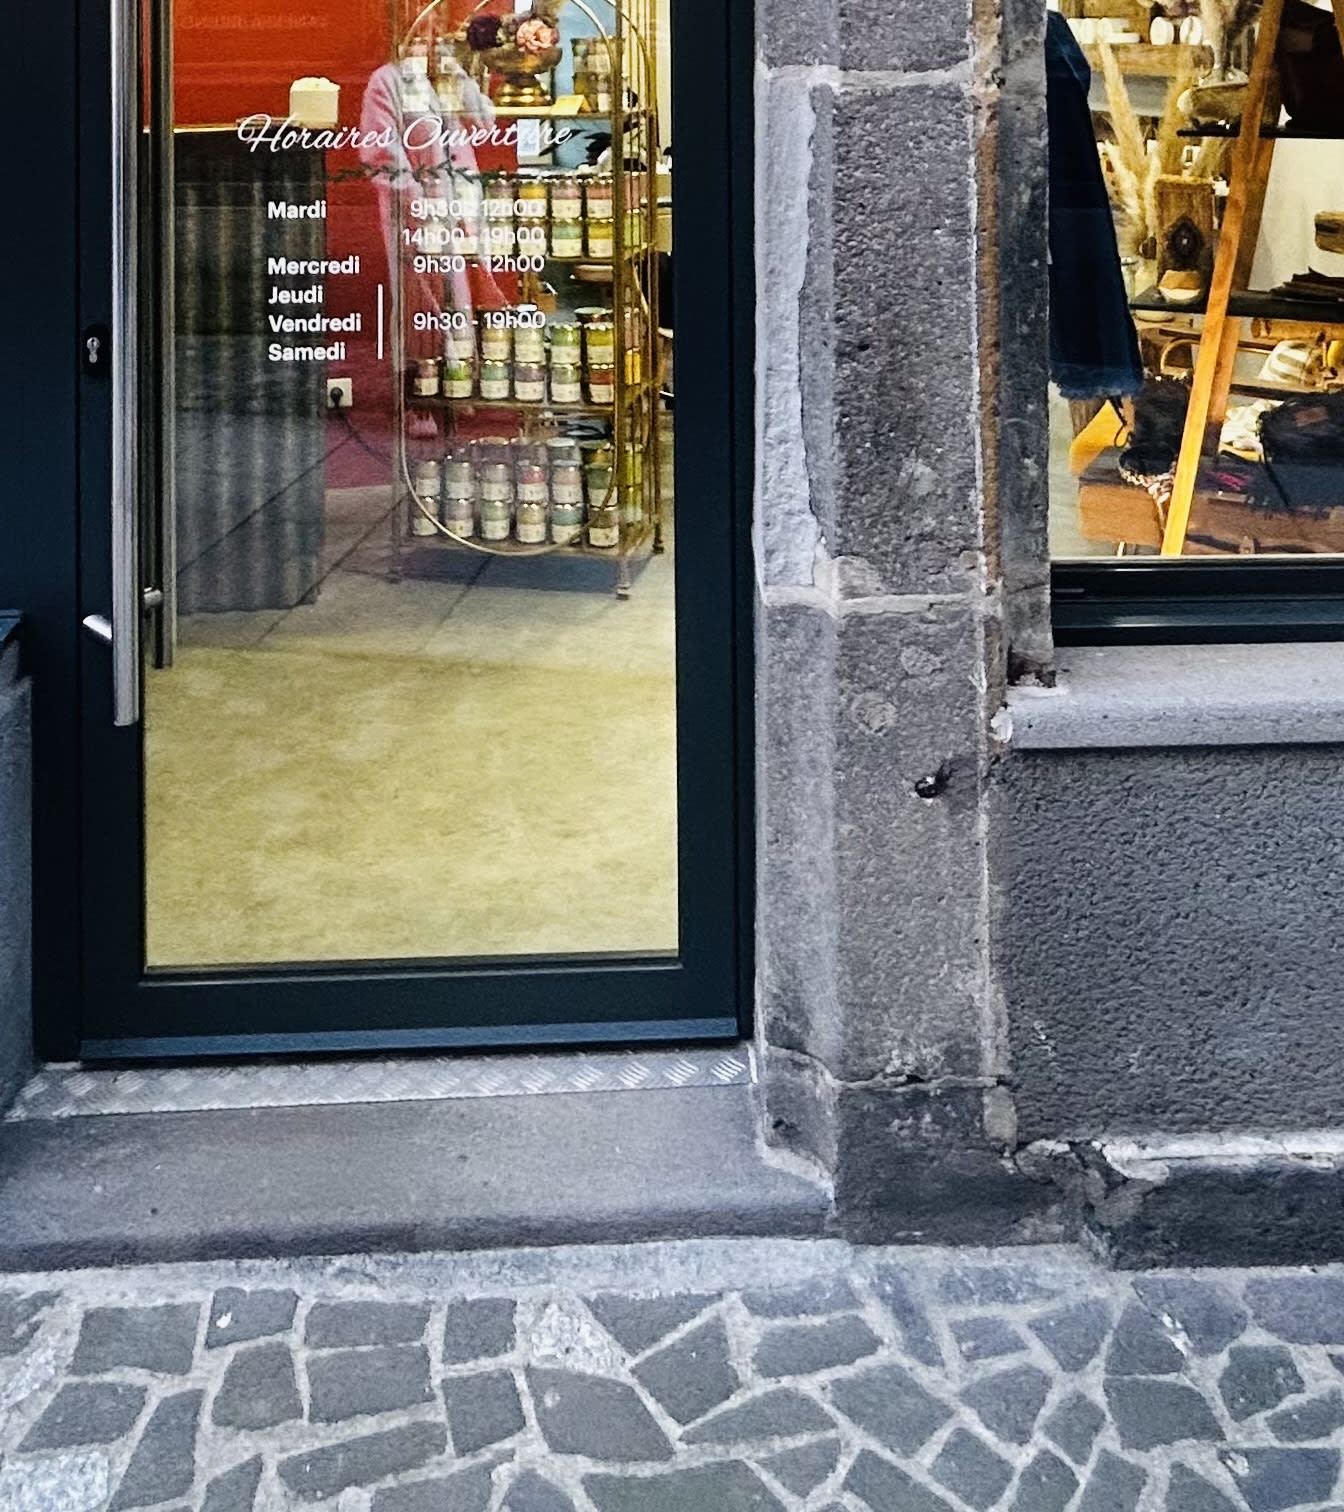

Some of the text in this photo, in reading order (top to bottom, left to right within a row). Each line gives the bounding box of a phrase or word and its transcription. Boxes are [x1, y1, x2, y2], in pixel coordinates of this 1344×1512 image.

[237, 114, 394, 153] Horaires
[267, 199, 542, 220] Mardi 9h30 12h00
[402, 227, 465, 246] 14h00
[482, 227, 545, 246] 19h00
[267, 255, 360, 276] Mercredi
[413, 255, 465, 273] 9h30
[485, 255, 545, 273] 12h00
[268, 285, 323, 305] Jeudi
[268, 313, 362, 334] Vendredi
[413, 312, 466, 331] 9h30
[483, 311, 547, 330] 19h00
[268, 342, 346, 362] Samedi
